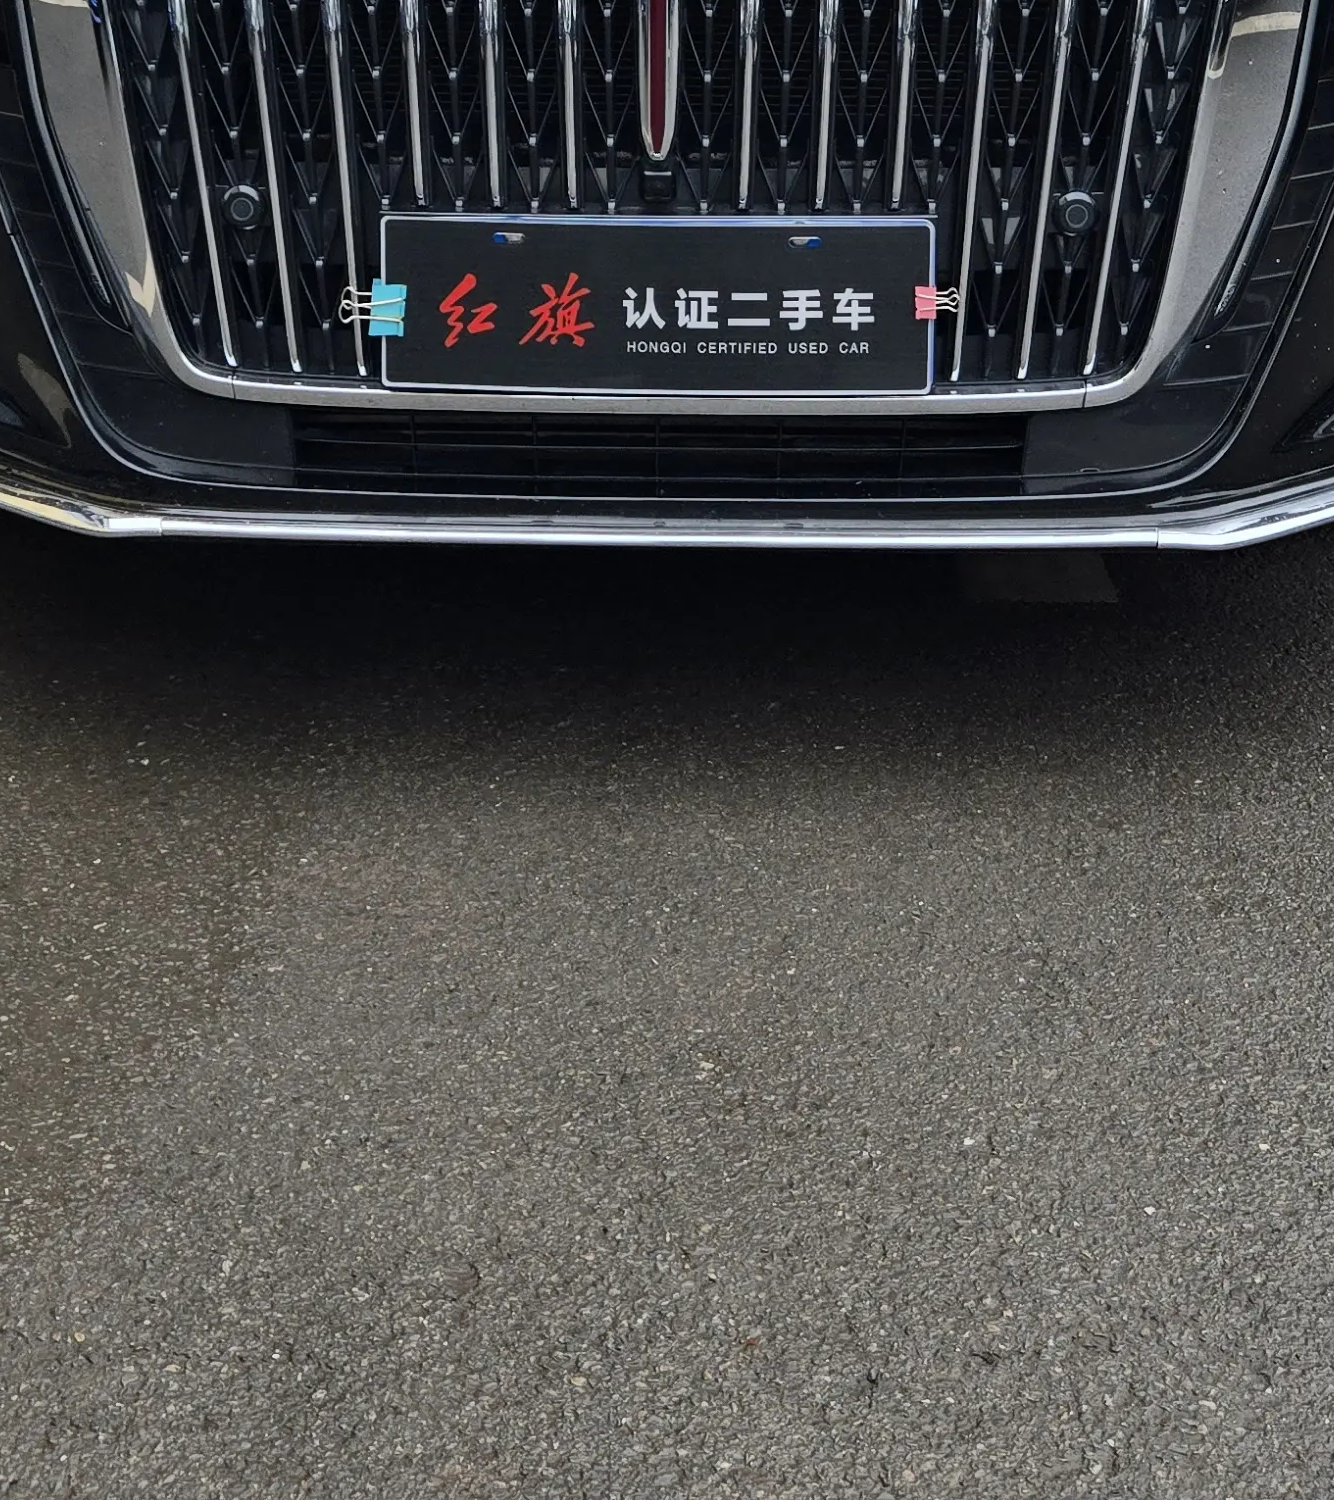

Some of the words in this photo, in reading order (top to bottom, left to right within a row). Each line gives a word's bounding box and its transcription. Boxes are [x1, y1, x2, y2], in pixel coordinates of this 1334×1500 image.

[439, 272, 595, 348] 红旗
[623, 287, 875, 331] 认证二手车
[626, 341, 687, 355] HONGQI
[697, 342, 778, 355] CERTIFIED
[788, 342, 829, 354] USED
[838, 341, 870, 354] CAR
